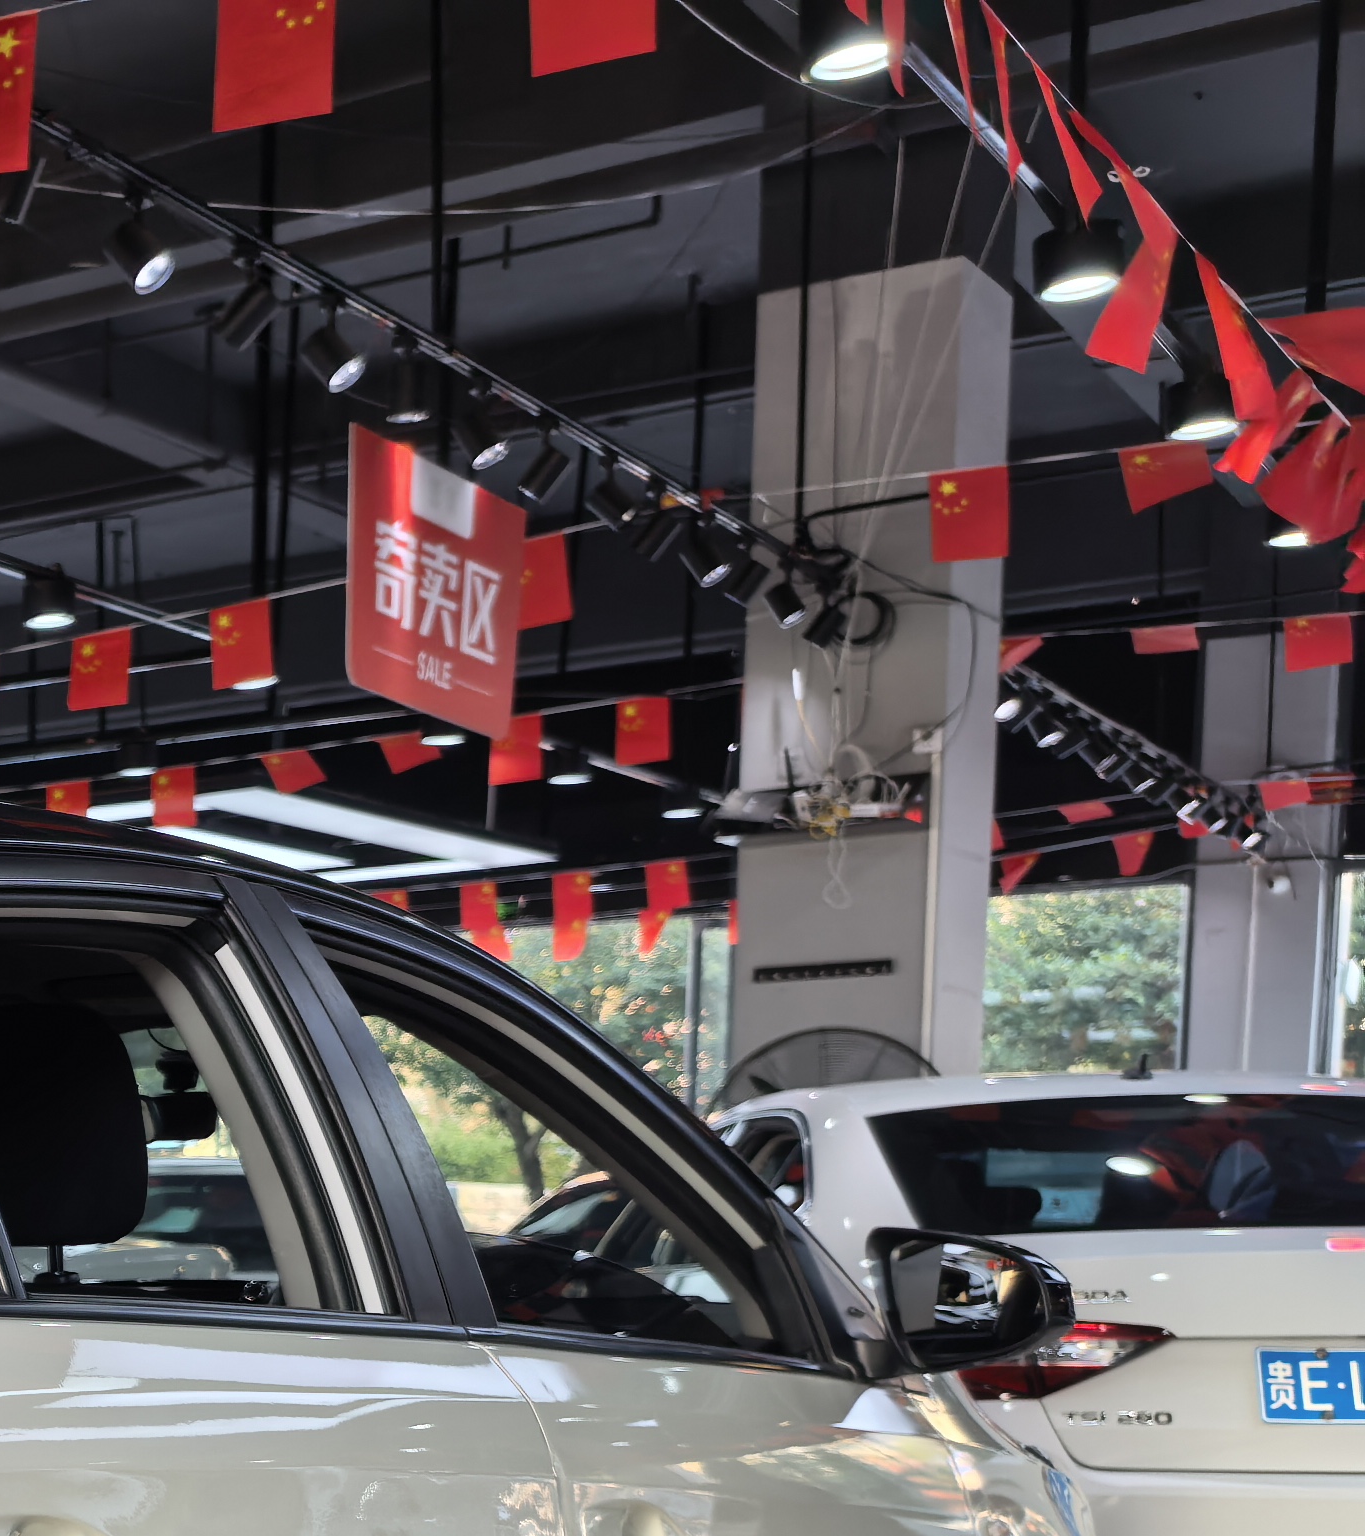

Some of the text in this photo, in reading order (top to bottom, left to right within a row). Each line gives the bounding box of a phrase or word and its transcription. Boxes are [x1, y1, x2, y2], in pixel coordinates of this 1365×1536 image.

[374, 519, 503, 665] 寄卖区
[417, 651, 453, 690] SALE
